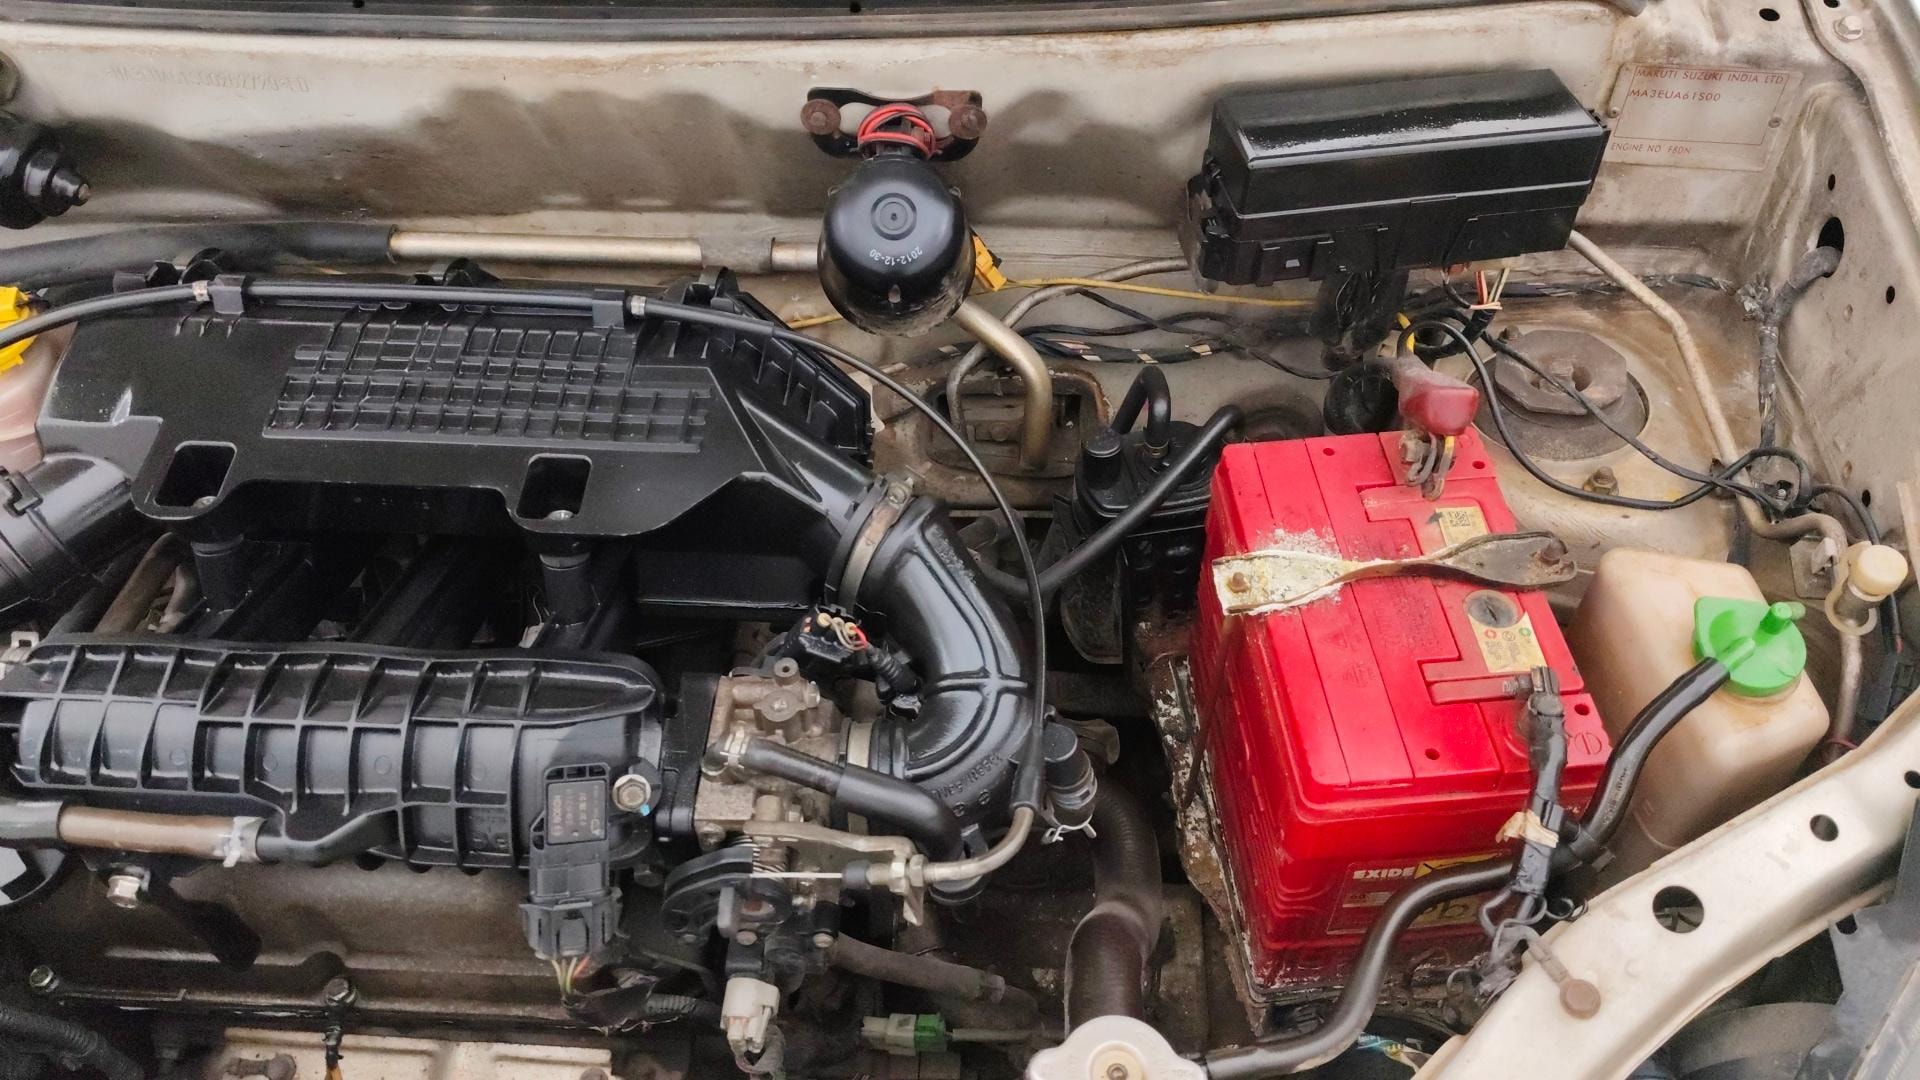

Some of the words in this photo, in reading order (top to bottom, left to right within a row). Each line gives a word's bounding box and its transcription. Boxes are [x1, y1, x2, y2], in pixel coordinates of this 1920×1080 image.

[1636, 68, 1679, 79] MARUTI
[1683, 70, 1723, 82] SUZUKI
[1728, 73, 1759, 83] INDIA
[1764, 75, 1784, 84] LTD
[1611, 142, 1644, 152] ENGINE
[869, 246, 923, 266] 2012-12-30
[1352, 866, 1416, 880] EXIDE
